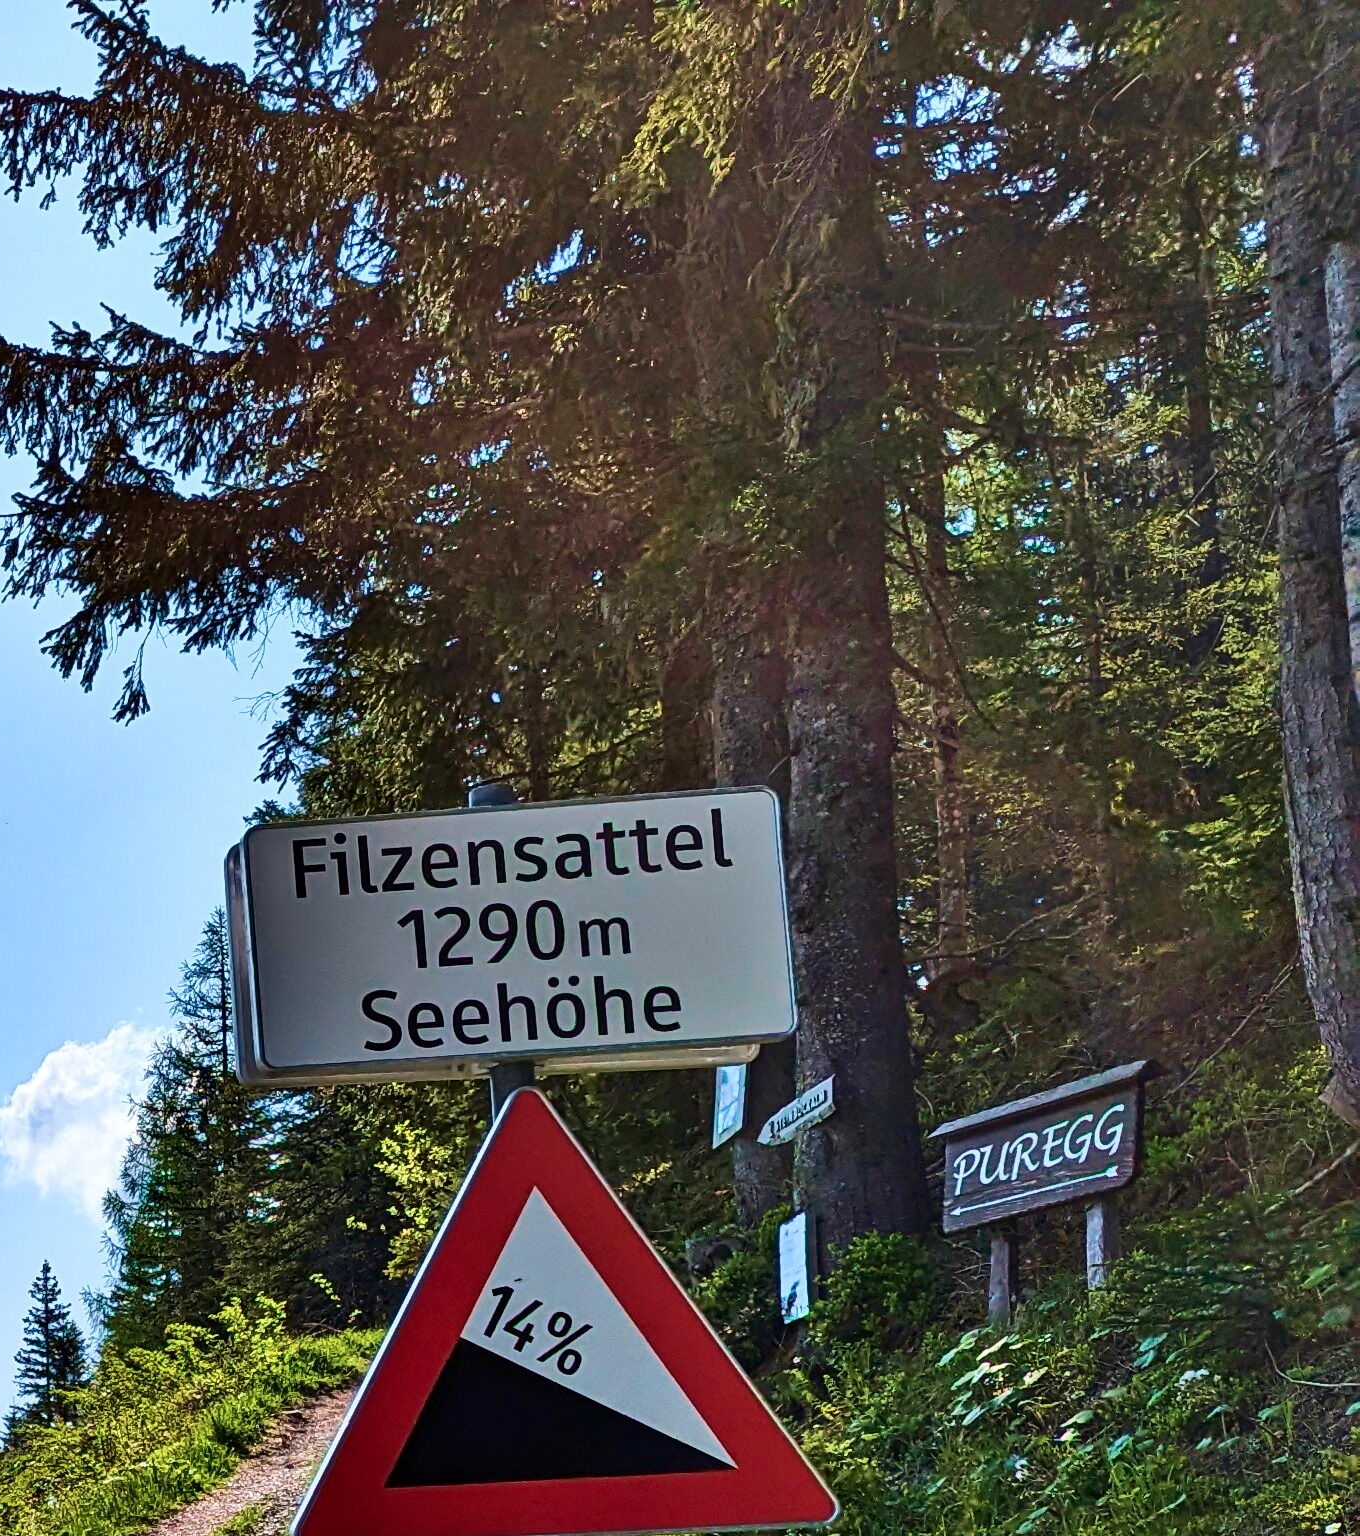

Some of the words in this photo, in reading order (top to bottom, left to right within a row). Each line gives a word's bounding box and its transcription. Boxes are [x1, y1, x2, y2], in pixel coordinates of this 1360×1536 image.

[292, 808, 733, 899] Filzensattel
[397, 900, 565, 968] 1290
[579, 916, 631, 957] m
[361, 975, 681, 1052] Seehöhe
[953, 1104, 1125, 1196] PUREGG
[483, 1286, 593, 1376] 14%
